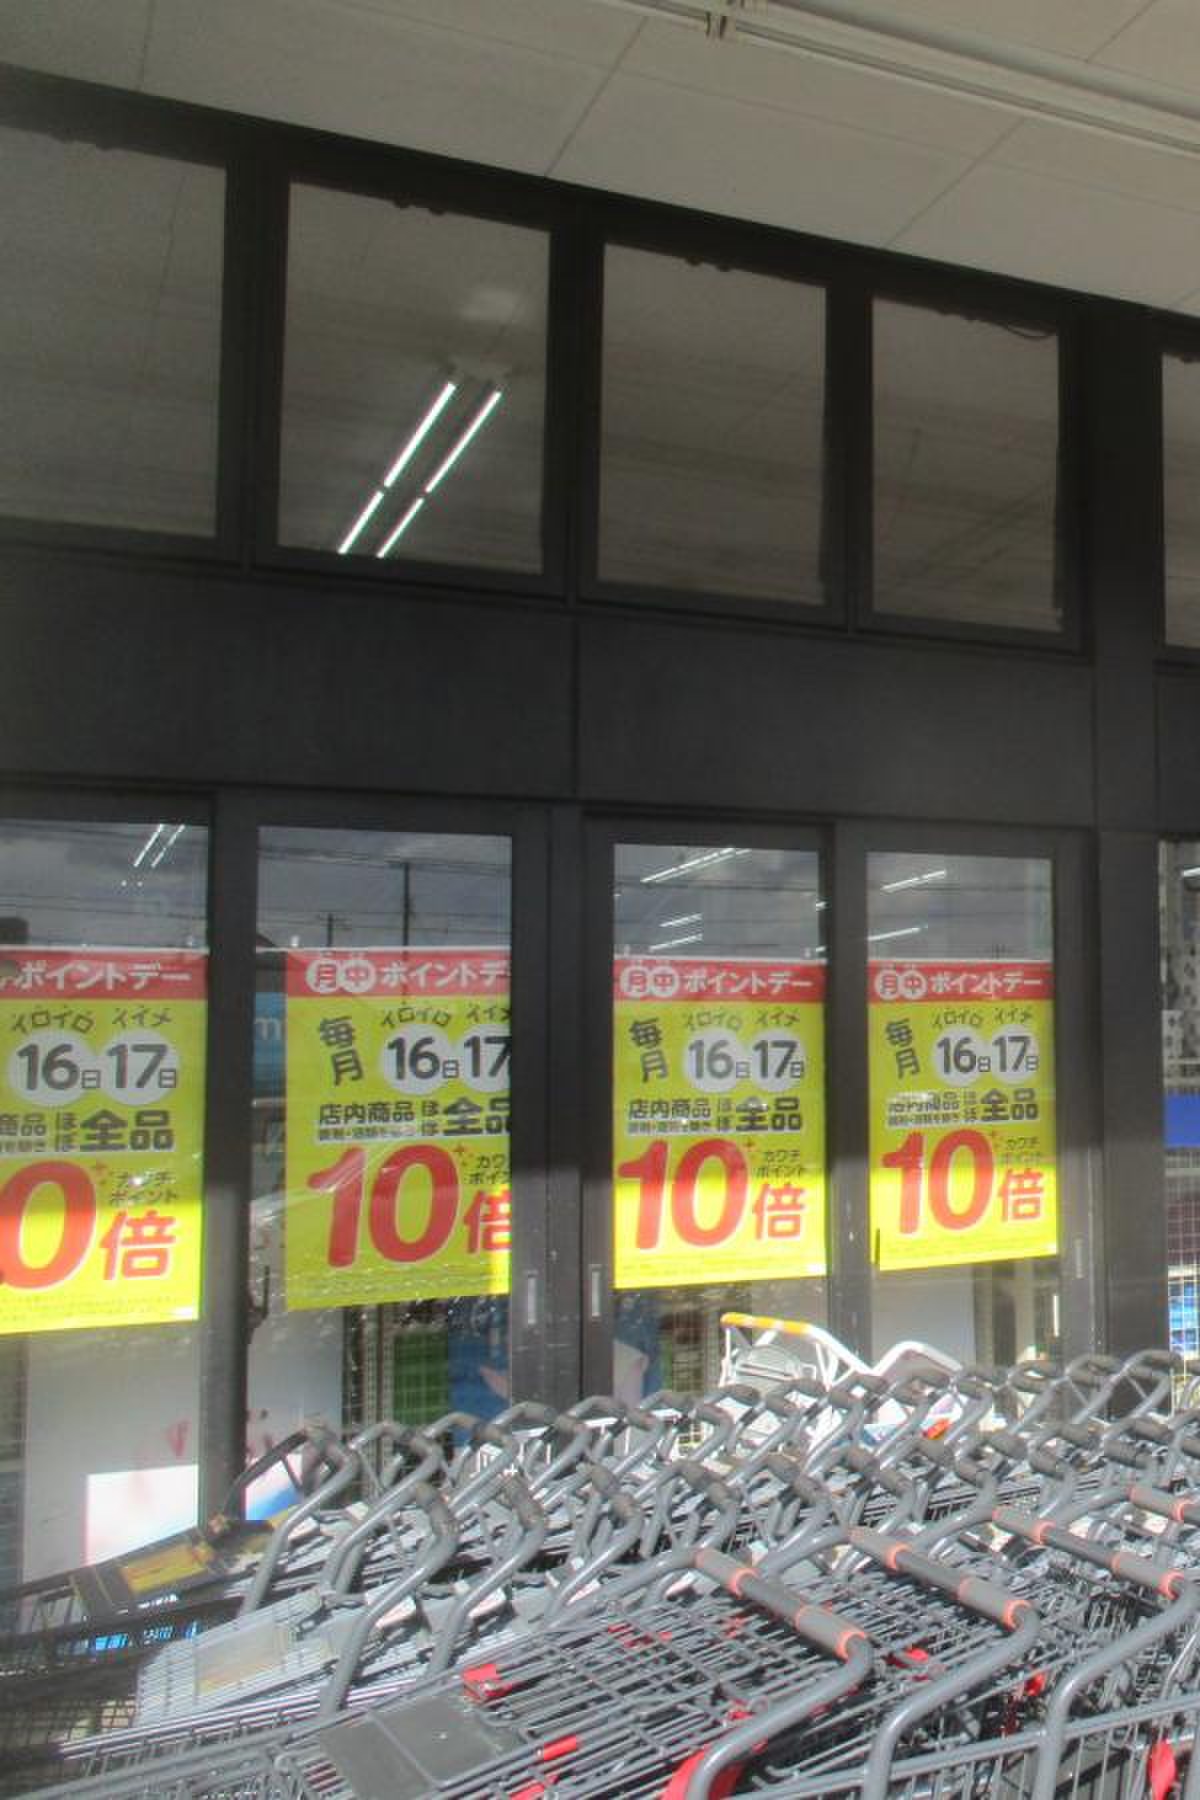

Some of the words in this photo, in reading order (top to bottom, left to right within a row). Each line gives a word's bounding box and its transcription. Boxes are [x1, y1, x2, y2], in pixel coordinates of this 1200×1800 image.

[0, 959, 192, 991] ポイントデー
[306, 959, 510, 993] 月中ポイントデ
[17, 1043, 100, 1091] 16日
[107, 1043, 177, 1089] 17日
[317, 1015, 363, 1086] 毎月
[387, 1036, 460, 1081] 16日
[464, 1035, 511, 1079] 17
[628, 1017, 668, 1083] 毎月
[688, 1039, 750, 1079] 16日
[752, 1039, 805, 1079] 17日
[885, 1018, 920, 1080] 毎月
[936, 1036, 991, 1075] 16日
[992, 1035, 1039, 1073] 17日
[319, 1101, 415, 1126] 店内商品
[629, 1098, 711, 1120] 店内商品
[736, 1095, 803, 1132] 全品
[980, 1088, 1039, 1121] 全品
[80, 1108, 175, 1151] 全品
